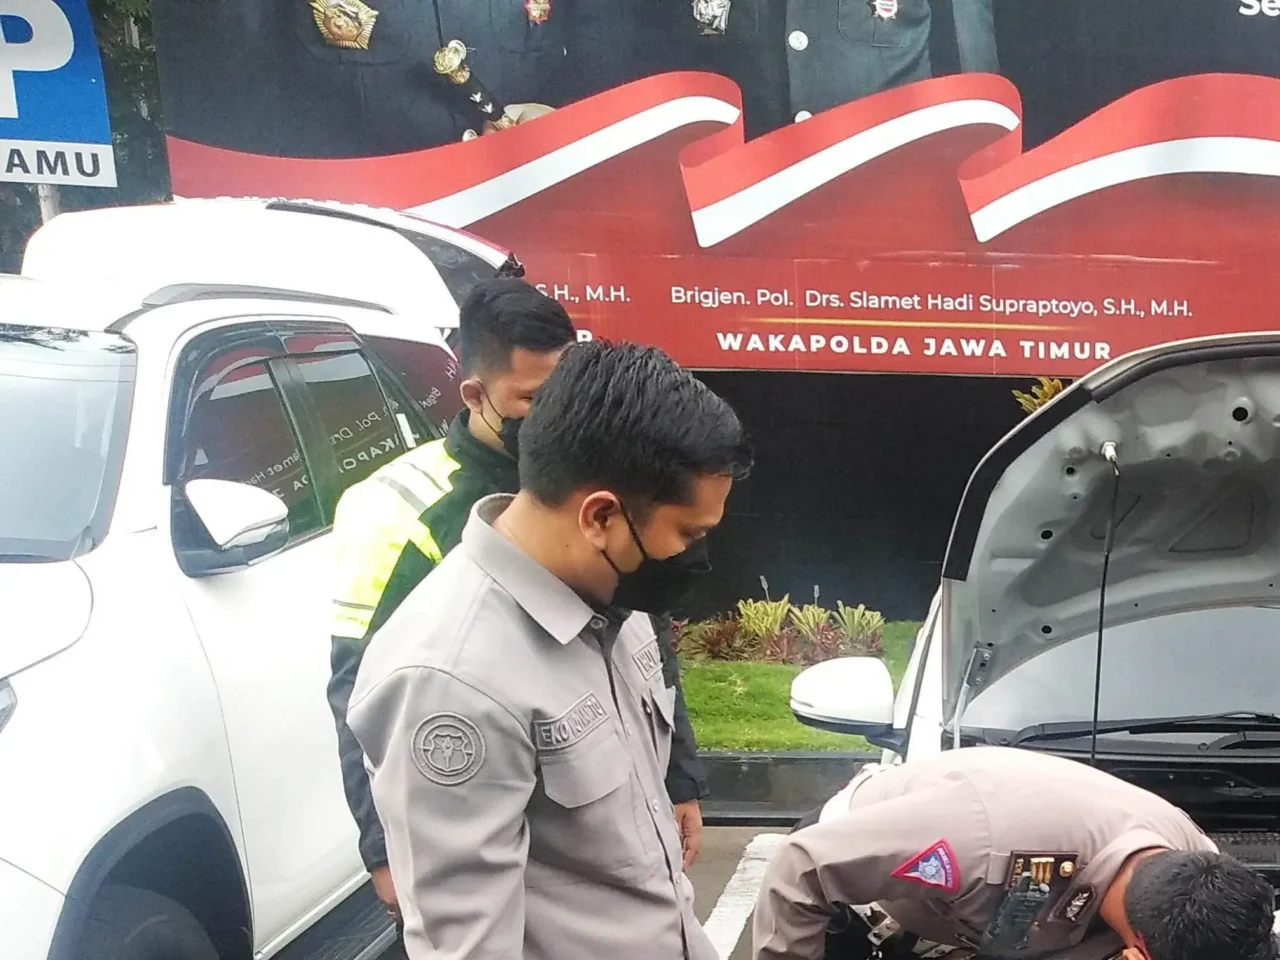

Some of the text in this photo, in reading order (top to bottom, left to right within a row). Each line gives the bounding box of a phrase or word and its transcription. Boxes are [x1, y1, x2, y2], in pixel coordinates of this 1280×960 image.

[586, 284, 631, 302] M.H.
[671, 287, 1193, 318] Brigjen. Pol. Drs. Slamet Hadi Supraptoyo, S.H., M.H.
[716, 332, 1111, 360] WAKAPOLDA JAWA TIMUR
